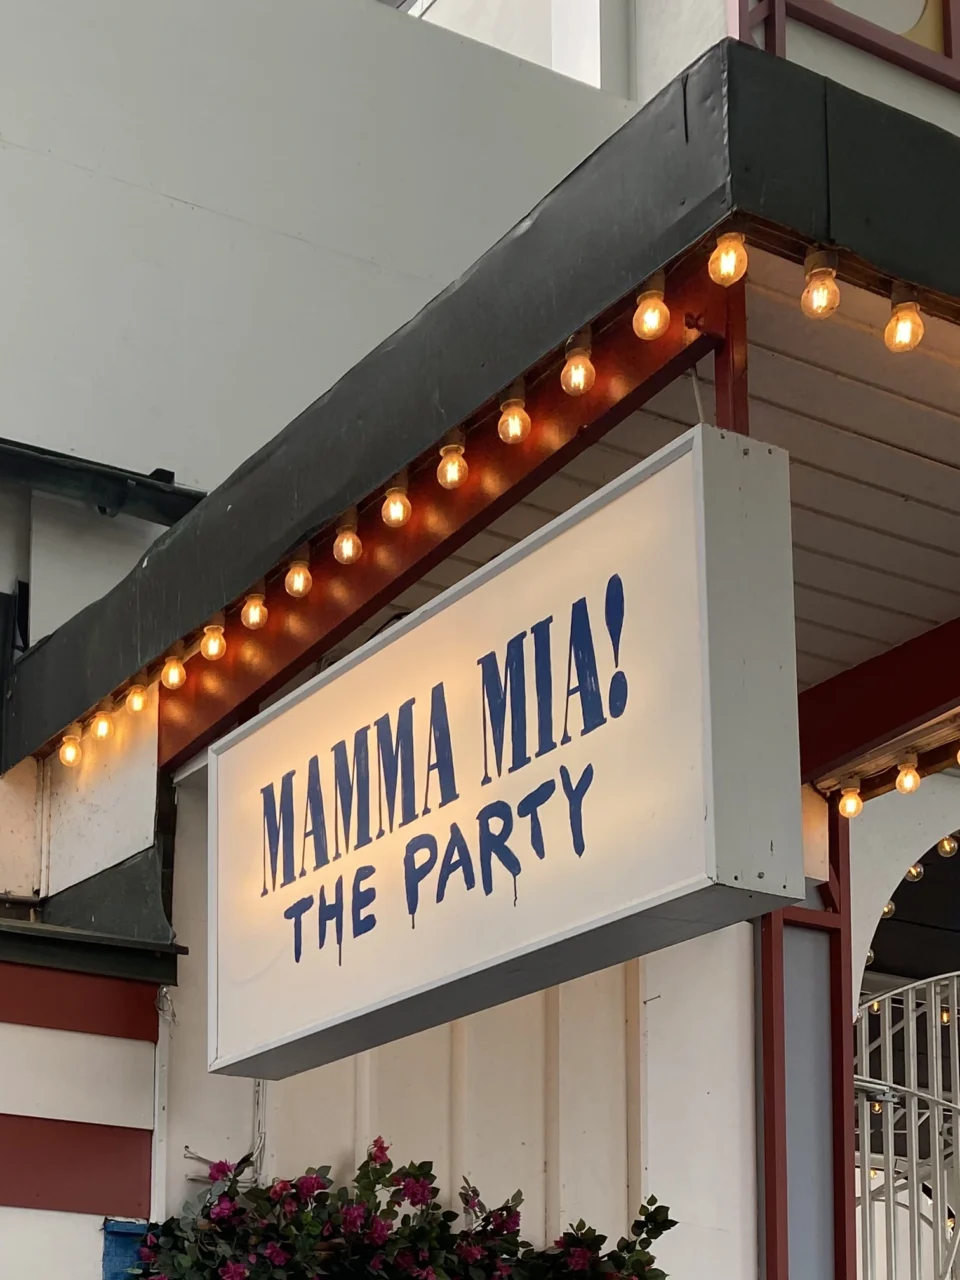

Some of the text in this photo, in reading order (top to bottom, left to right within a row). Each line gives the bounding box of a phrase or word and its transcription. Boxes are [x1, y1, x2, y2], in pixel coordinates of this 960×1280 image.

[259, 572, 629, 898] MAMMA MIA!
[284, 762, 595, 967] THE PARTY
